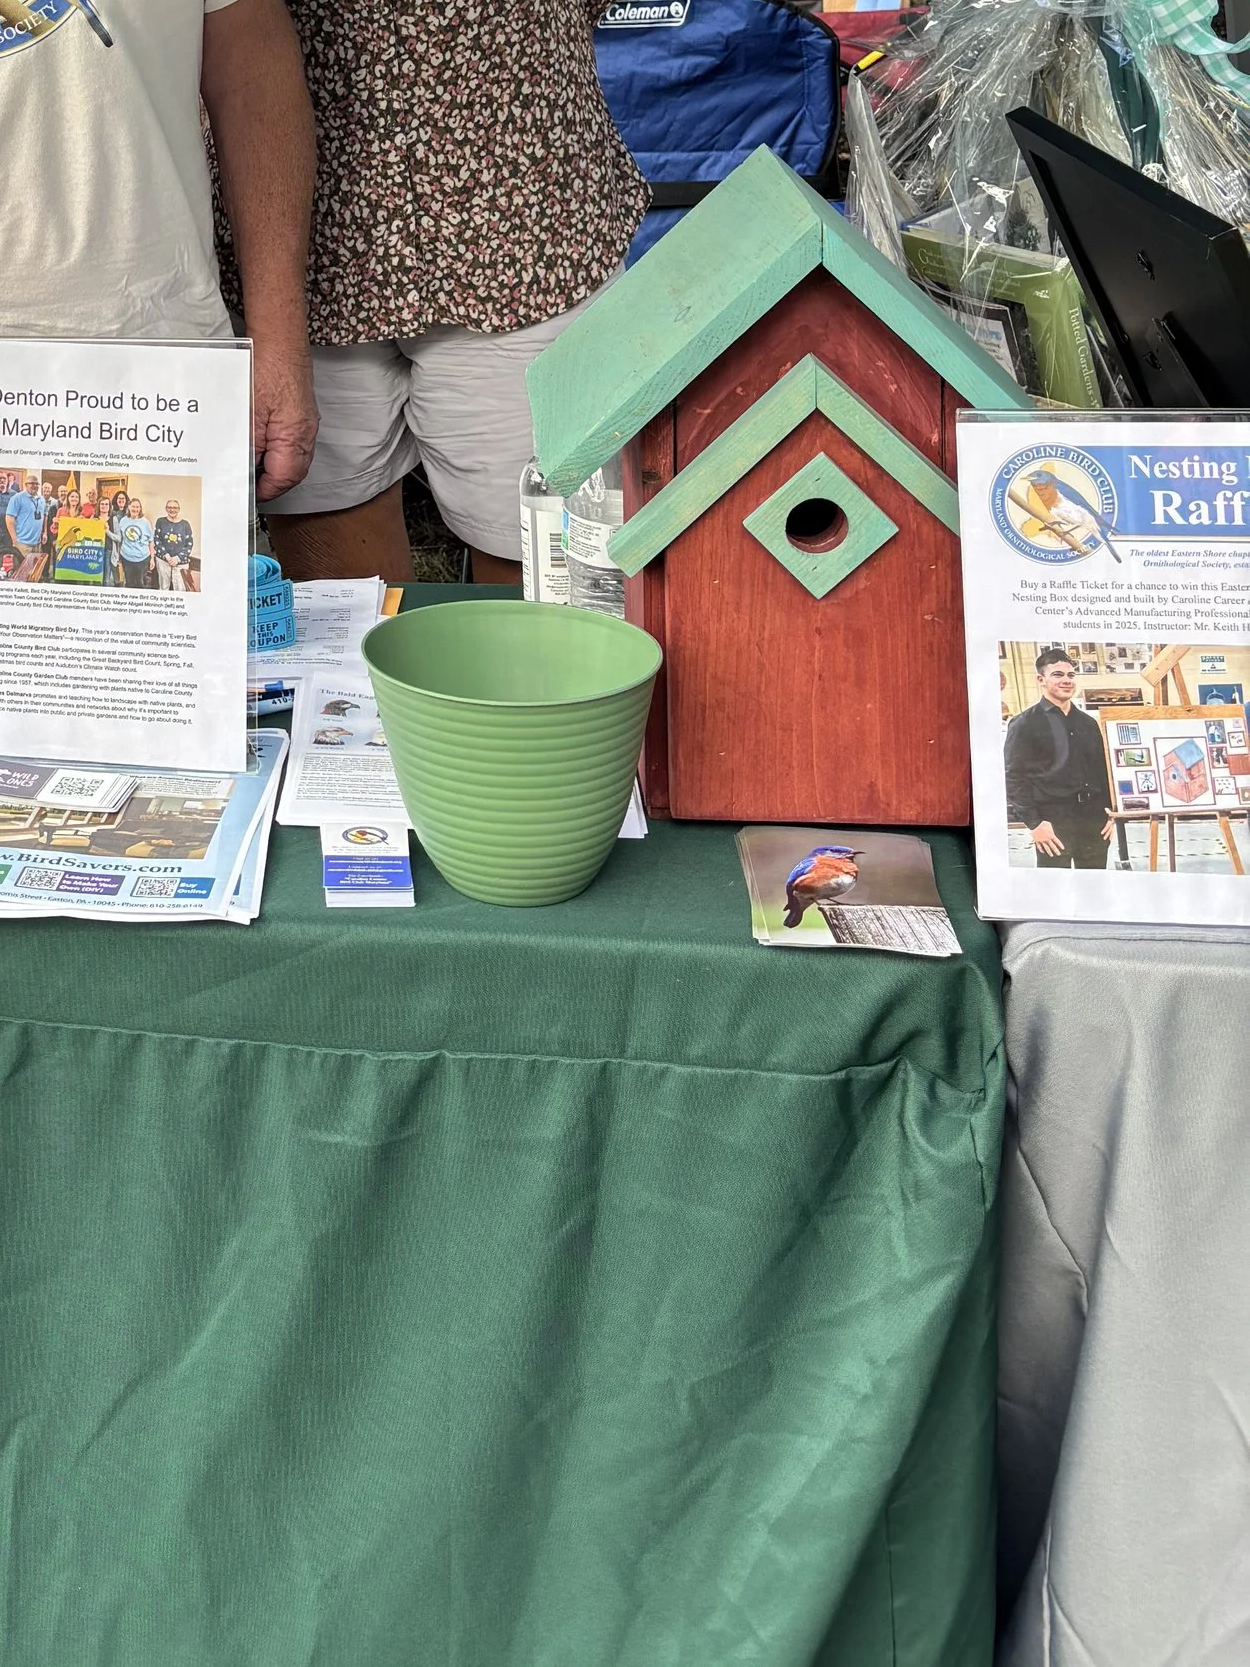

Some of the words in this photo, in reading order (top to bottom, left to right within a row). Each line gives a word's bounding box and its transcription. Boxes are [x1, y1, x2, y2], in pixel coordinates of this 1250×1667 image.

[605, 4, 670, 20] Coleman
[1069, 307, 1087, 344] Potted
[1078, 345, 1094, 396] Gardens
[65, 390, 124, 409] Proud
[131, 395, 148, 410] to
[156, 394, 180, 412] be
[187, 399, 199, 413] a
[2, 418, 92, 441] Maryland
[100, 422, 138, 441] Bird
[145, 424, 184, 447] City
[1128, 454, 1238, 486] Nesting
[1003, 446, 1065, 479] CAROLINE
[1069, 451, 1100, 480] BIRD
[1098, 478, 1114, 513] CLUB
[1149, 490, 1250, 526] Raff
[995, 488, 1007, 529] MARYLAND
[1004, 528, 1065, 560] ORNITHOLOGICAL
[1130, 549, 1144, 557] The
[1146, 549, 1169, 557] oldest
[1202, 550, 1226, 558] Shore
[1143, 560, 1199, 569] Ornithological
[1201, 561, 1231, 570] Society,
[1020, 580, 1039, 590] Buy
[1049, 580, 1077, 589] Raffle
[1079, 580, 1108, 590] Ticket
[1111, 581, 1124, 590] for
[1135, 581, 1167, 590] chance
[1169, 583, 1178, 591] to
[1201, 582, 1218, 591] this
[1221, 582, 1250, 591] Easter
[249, 592, 282, 610] ICKET
[1012, 593, 1047, 603] Nesting
[1050, 594, 1069, 602] Box
[1071, 594, 1111, 605] designed
[1114, 595, 1131, 603] and
[1133, 595, 1154, 603] built
[1157, 595, 1168, 605] by
[1171, 595, 1211, 604] Caroline
[1213, 596, 1245, 605] Career
[1035, 606, 1073, 615] Center's
[1075, 607, 1121, 616] Advanced
[1124, 608, 1191, 619] Manufacturing
[29, 624, 54, 633] Migratory
[252, 622, 278, 633] KEEP
[1063, 620, 1101, 629] students
[1104, 620, 1112, 629] in
[1144, 621, 1191, 631] Instructor:
[1194, 622, 1210, 631] Mr.
[1213, 622, 1239, 632] Keith
[250, 634, 286, 647] OUPON
[318, 688, 335, 696] The
[359, 693, 376, 701] Eag
[12, 771, 39, 780] WILD
